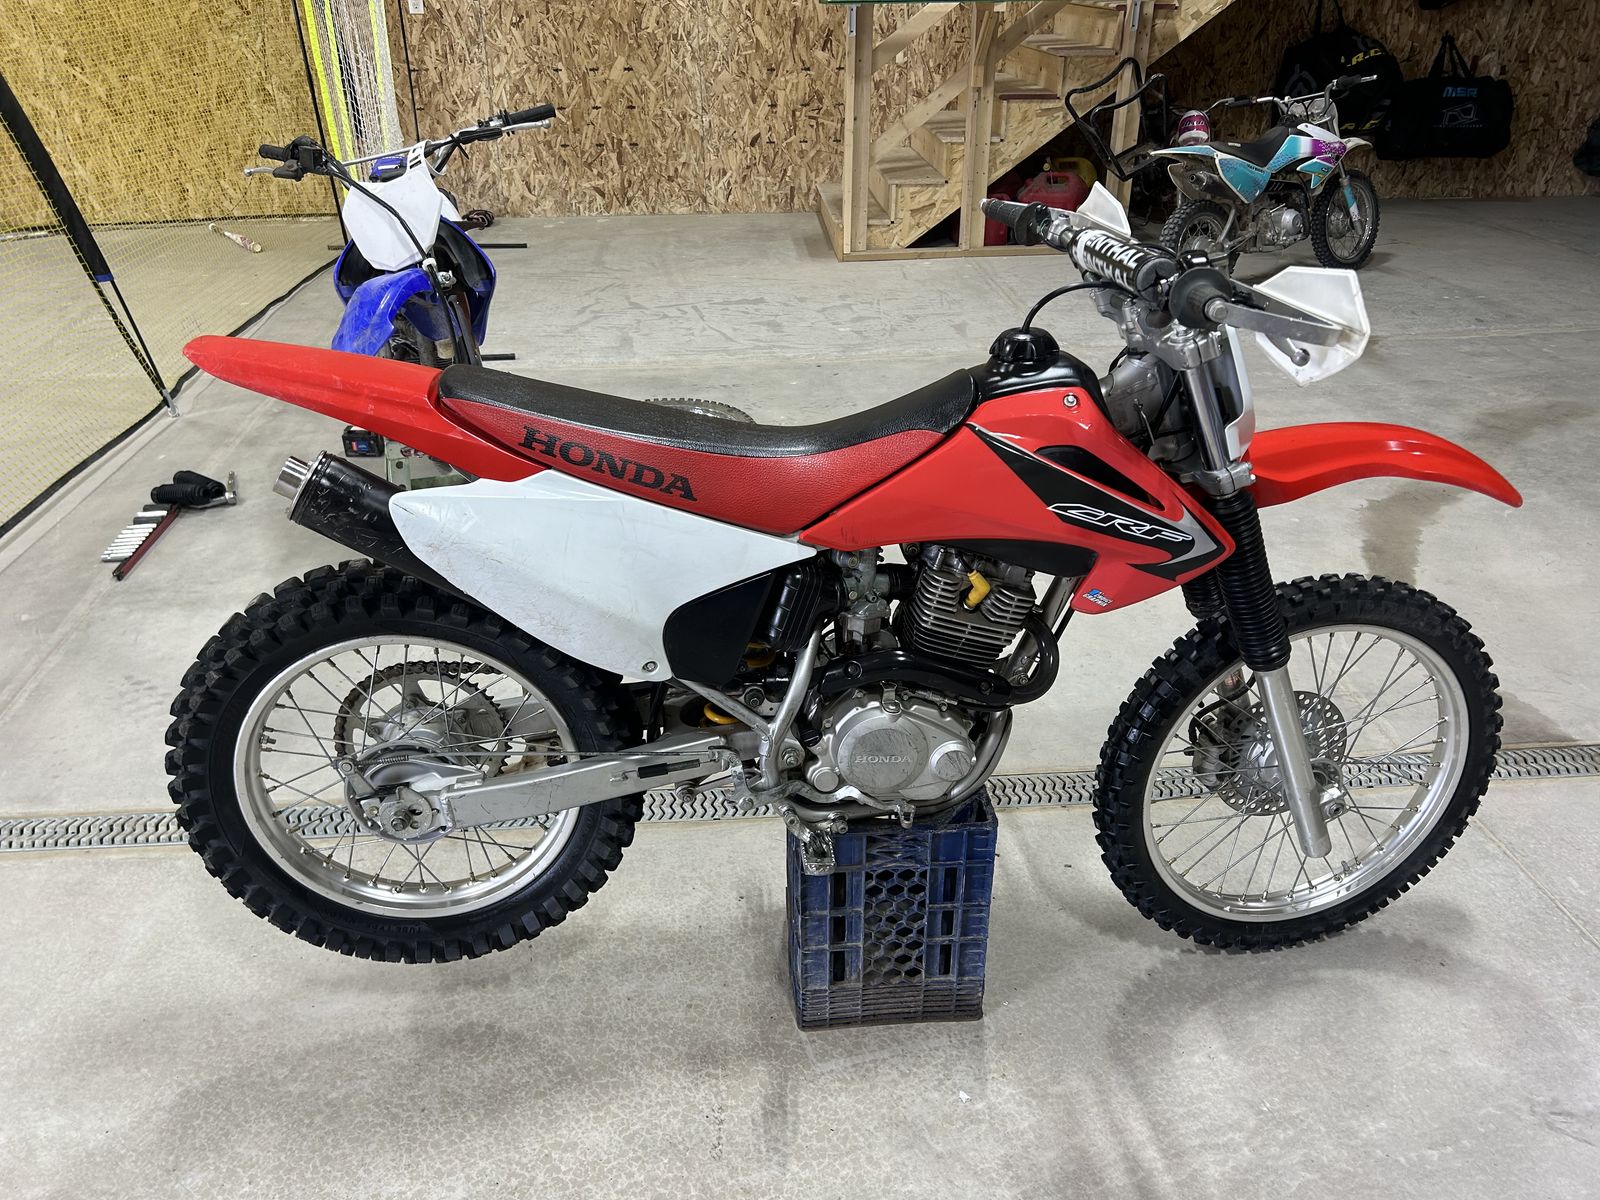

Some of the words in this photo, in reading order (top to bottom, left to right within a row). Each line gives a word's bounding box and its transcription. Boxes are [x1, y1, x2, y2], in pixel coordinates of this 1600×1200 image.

[1442, 86, 1478, 98] MSR
[518, 425, 698, 502] HONDA
[1046, 503, 1193, 542] CRF
[855, 755, 912, 763] HONDA
